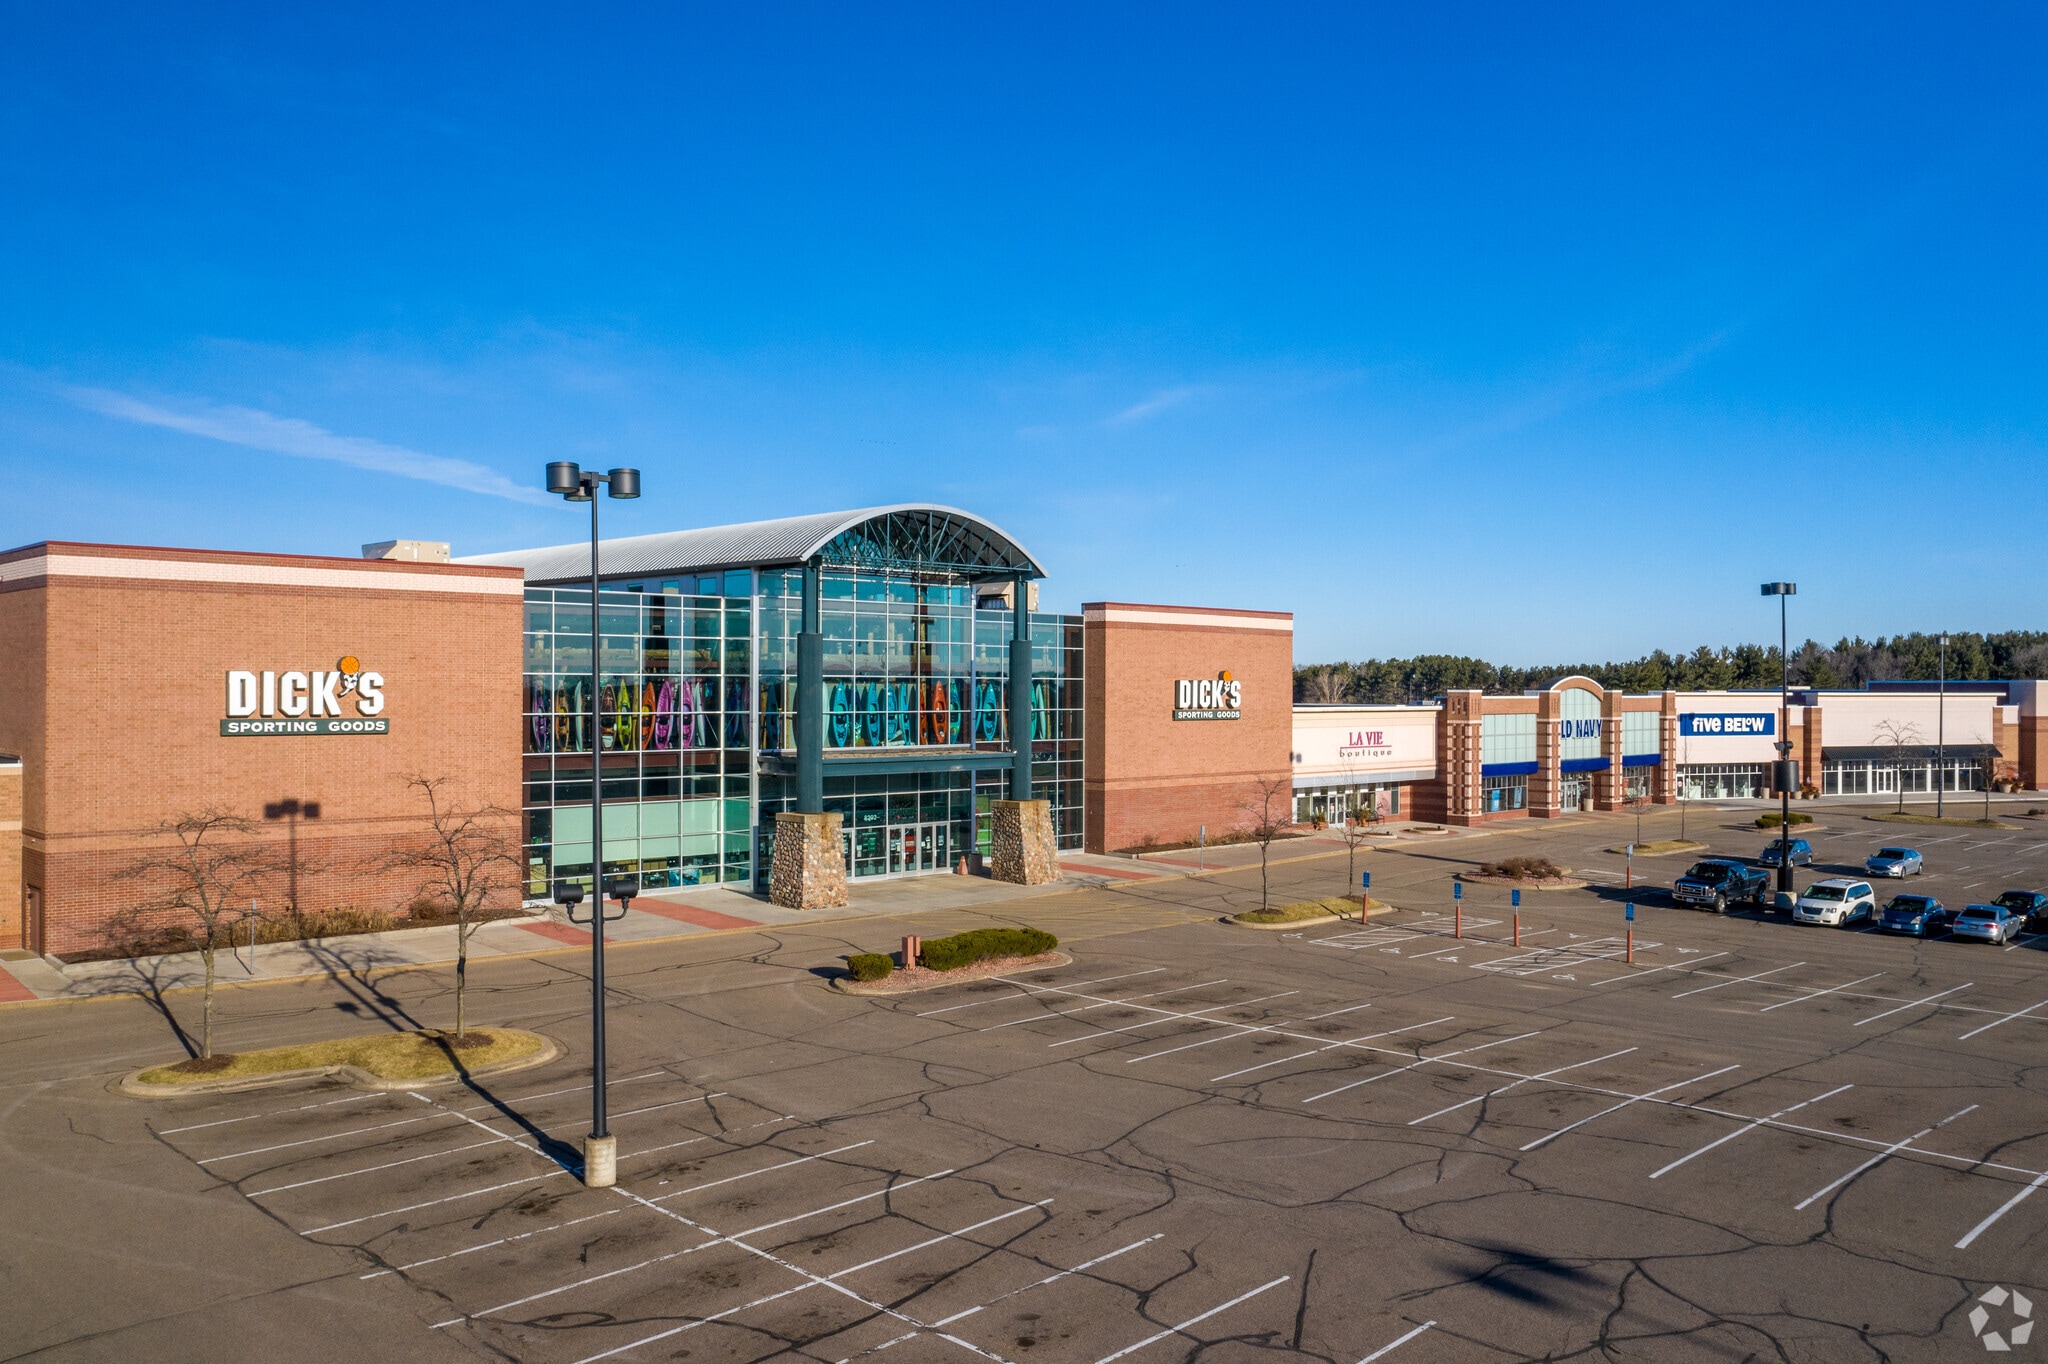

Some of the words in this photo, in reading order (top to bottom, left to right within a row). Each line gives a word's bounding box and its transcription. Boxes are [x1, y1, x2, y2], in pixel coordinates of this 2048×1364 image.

[227, 669, 385, 717] DICK'S
[1179, 680, 1241, 708] DICK'S
[227, 721, 318, 733] SPORTING
[328, 720, 386, 732] GOODS
[1576, 718, 1603, 738] NAVY
[1349, 731, 1363, 746] LA
[1365, 731, 1383, 745] VIE
[1339, 748, 1392, 757] boutique
